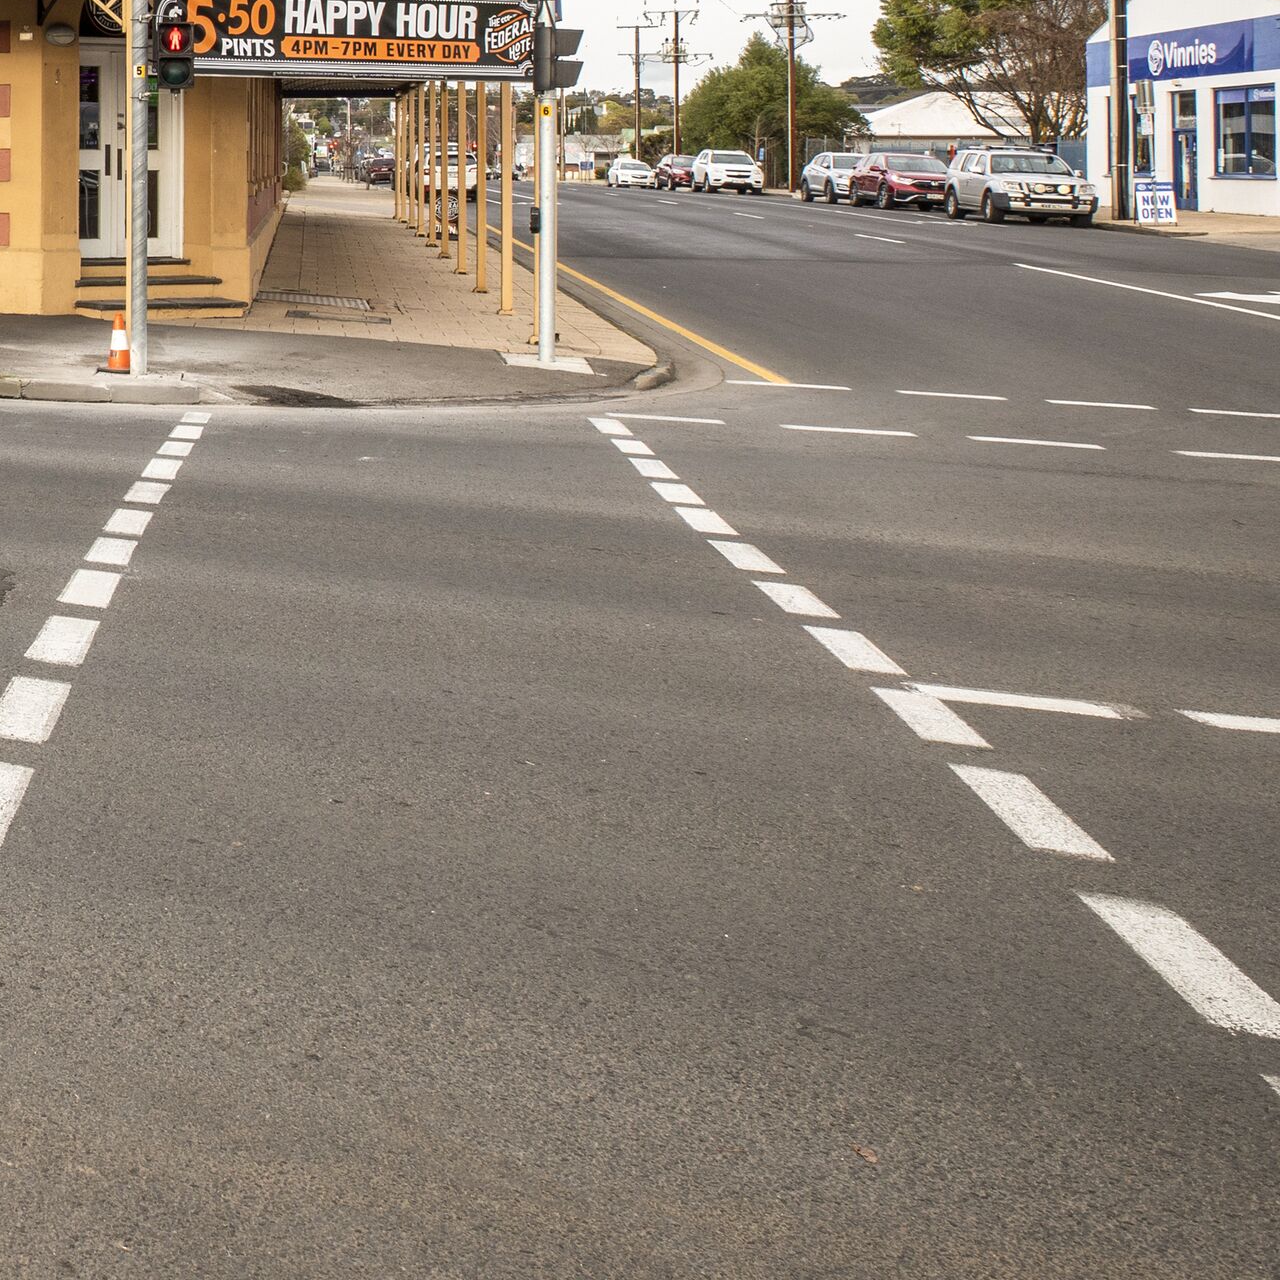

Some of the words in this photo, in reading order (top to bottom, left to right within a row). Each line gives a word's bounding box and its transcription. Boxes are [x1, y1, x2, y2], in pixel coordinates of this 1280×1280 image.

[395, 2, 479, 40] HOUR
[220, 37, 276, 58] PINTS
[386, 41, 441, 59] EVERY
[442, 44, 471, 60] DAY
[1163, 38, 1217, 69] Vinnies
[136, 66, 142, 76] 5
[543, 106, 549, 115] 6
